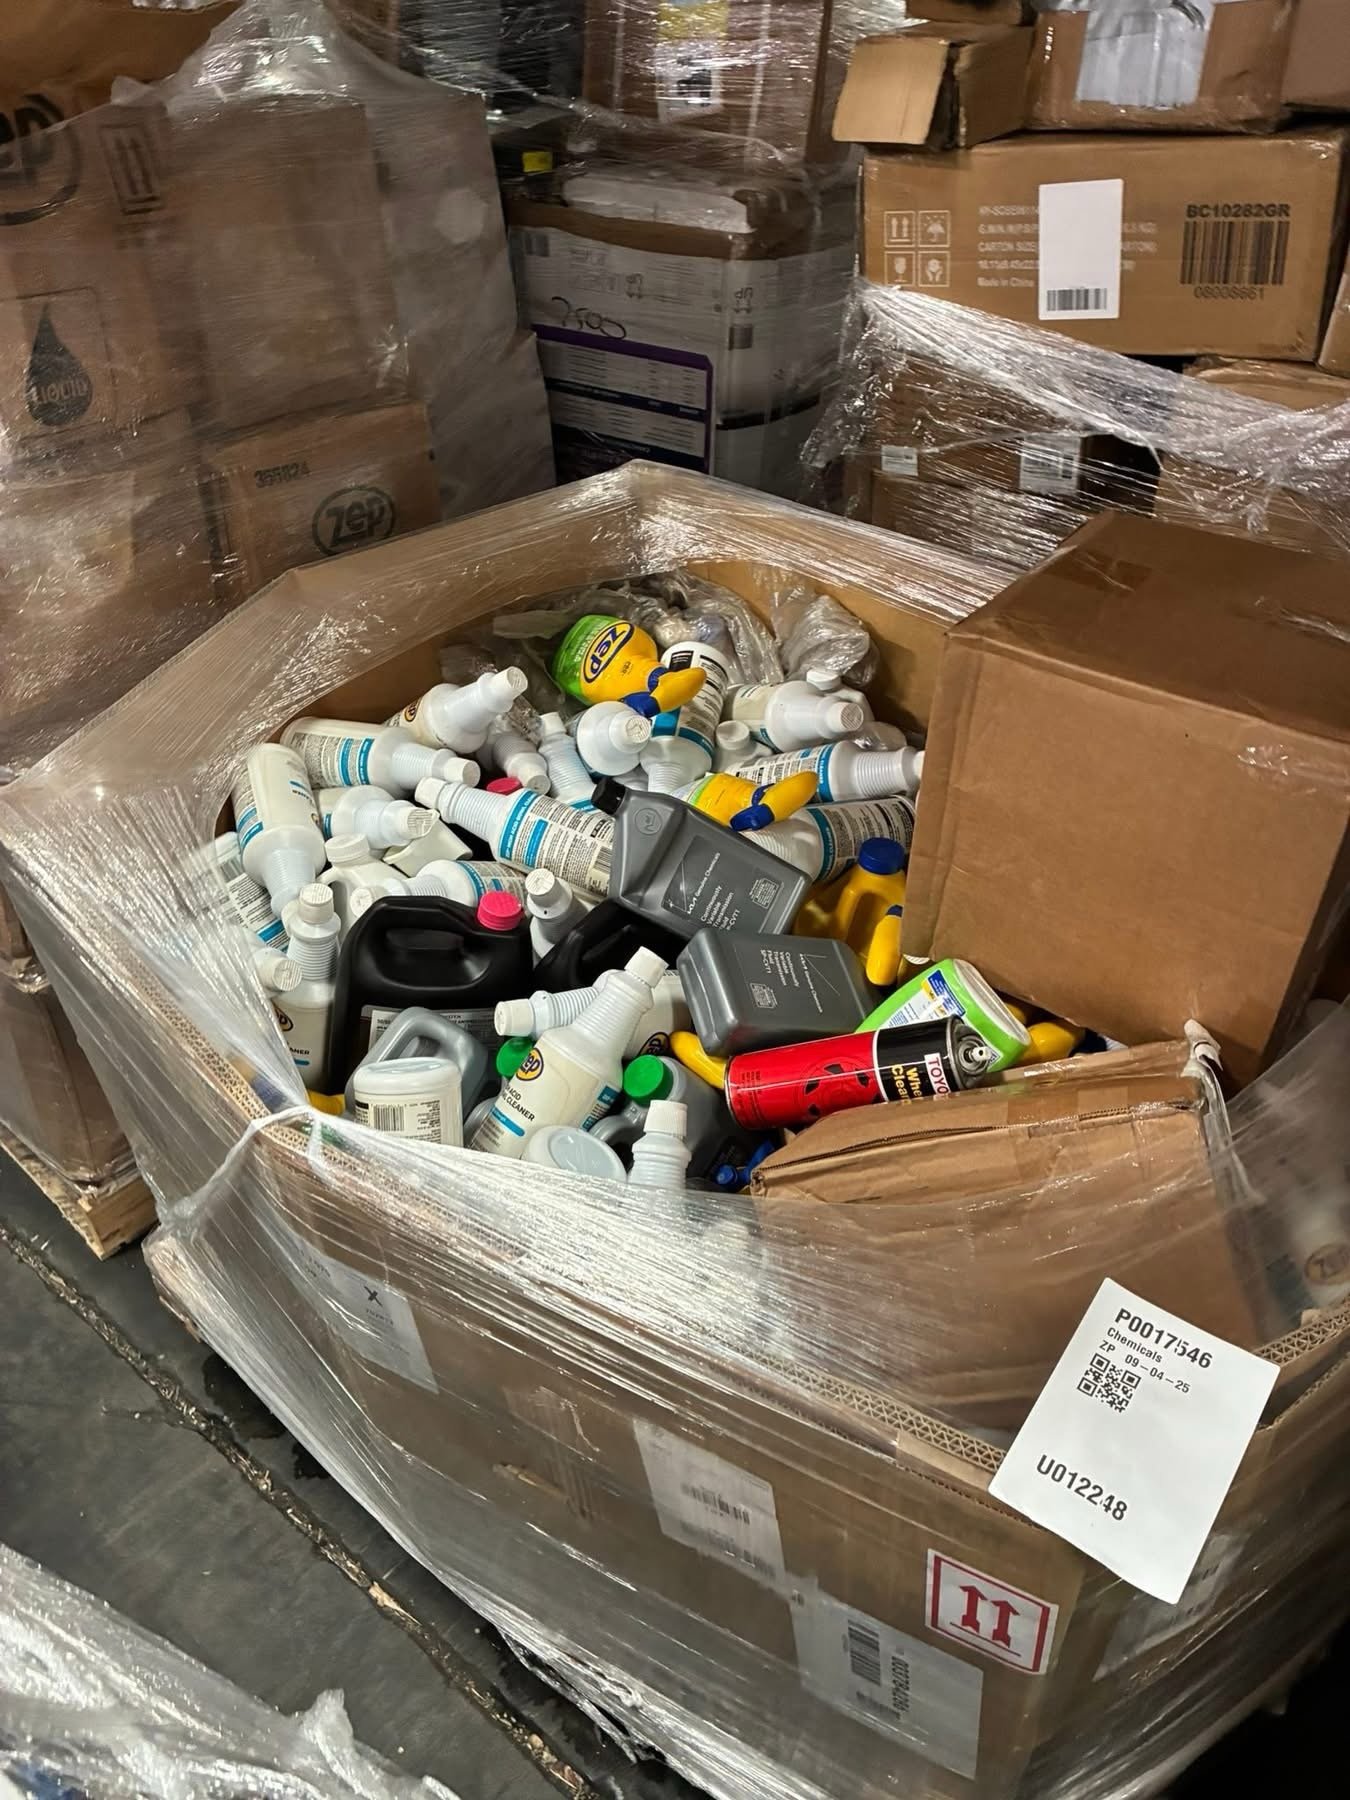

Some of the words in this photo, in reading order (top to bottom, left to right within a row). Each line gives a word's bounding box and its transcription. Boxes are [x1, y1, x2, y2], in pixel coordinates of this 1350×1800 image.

[700, 885, 722, 922] Continuously
[706, 902, 721, 925] Variable
[712, 892, 734, 928] Transmission
[785, 951, 800, 988] Continuously
[906, 1067, 922, 1097] Whe
[928, 1057, 949, 1094] TOYO
[506, 1096, 536, 1122] CLEANER
[509, 1087, 522, 1101] ACID
[1099, 1340, 1116, 1353] ZP
[1107, 1327, 1163, 1363] Chemicals
[1114, 1308, 1213, 1368] P0017546
[1036, 1454, 1128, 1521] U012248
